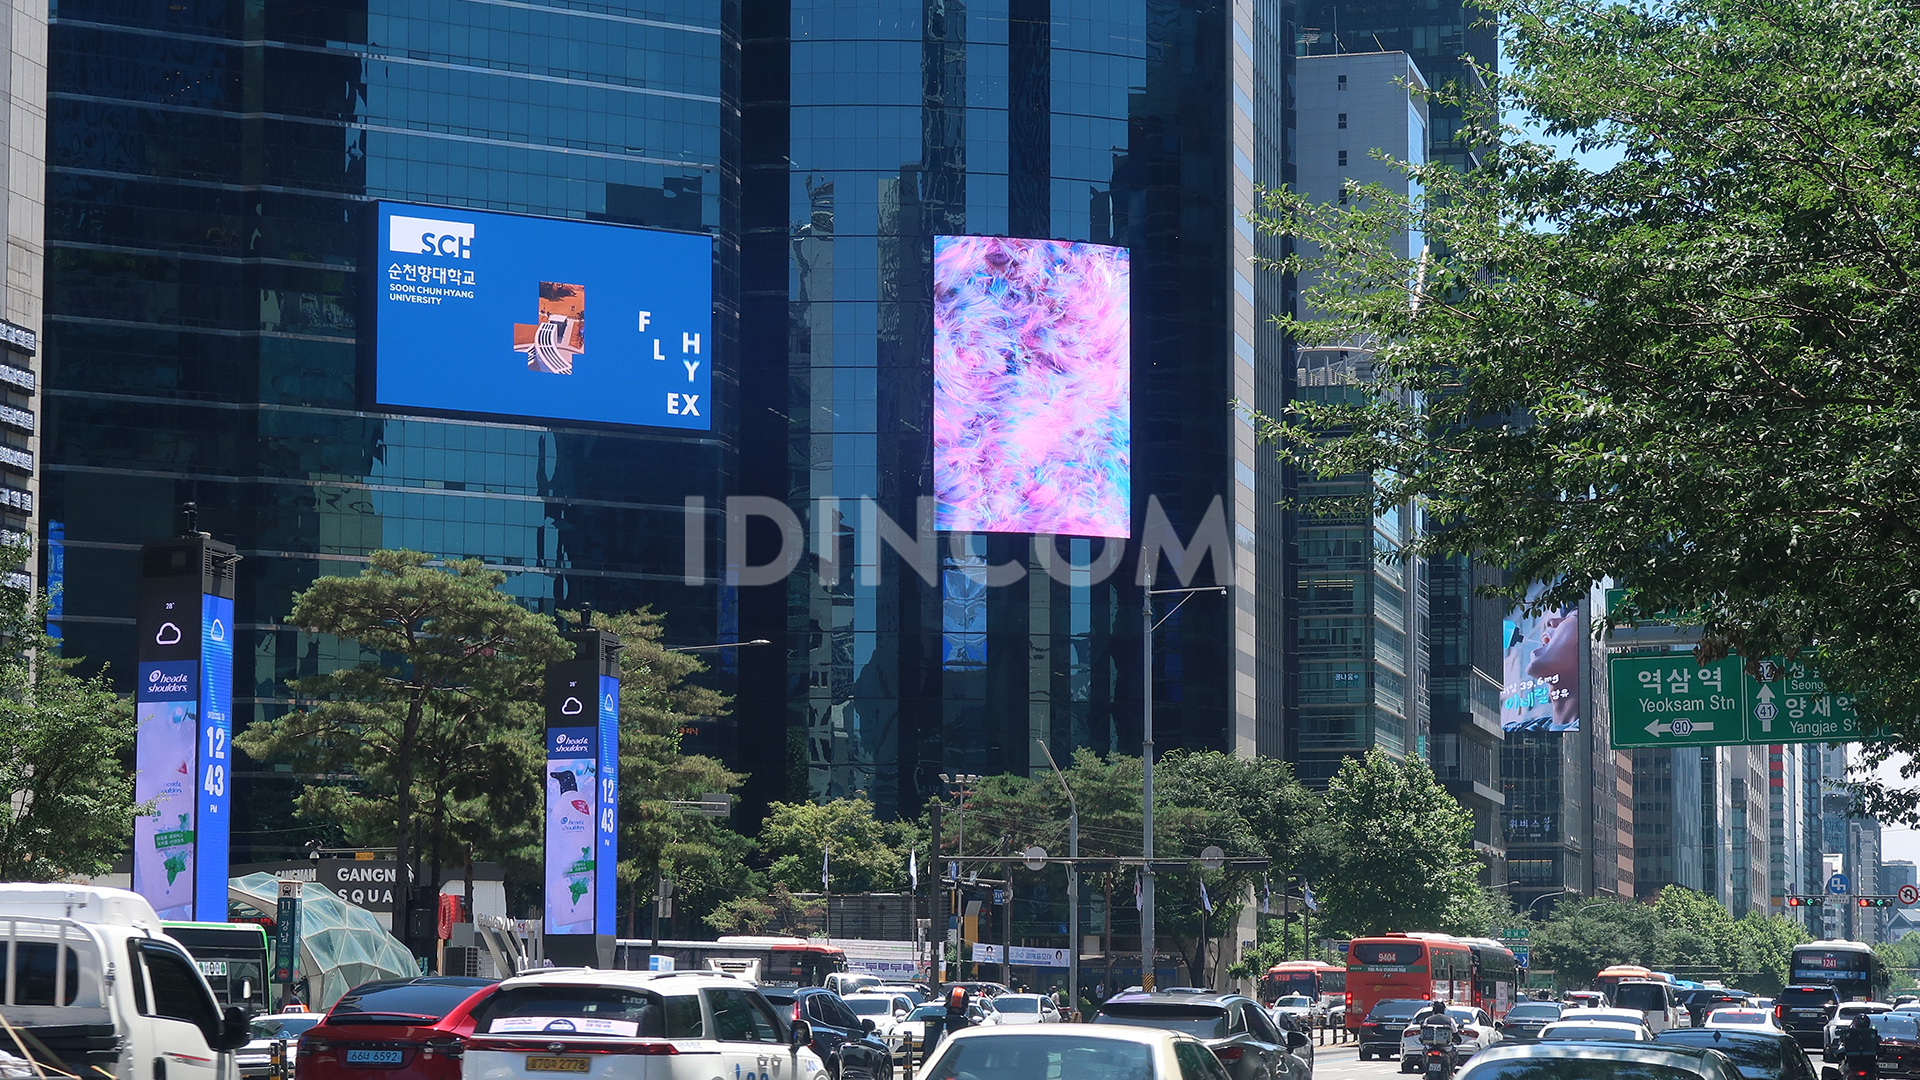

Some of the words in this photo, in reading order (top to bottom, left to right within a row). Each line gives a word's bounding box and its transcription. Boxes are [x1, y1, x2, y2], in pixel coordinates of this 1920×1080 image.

[421, 232, 470, 258] SCH
[388, 263, 476, 286] 순천향대학교
[389, 283, 416, 293] SOON
[416, 286, 442, 296] CHUN
[443, 289, 474, 299] HYANG
[389, 293, 442, 305] UNIVERSITY
[148, 683, 188, 693] shoulders
[1520, 674, 1559, 690] 39.6mg
[1638, 667, 1721, 694] 역삼역
[1791, 679, 1824, 691] Seong
[1639, 698, 1705, 712] Yeoksam
[1710, 695, 1735, 710] Stn
[1760, 706, 1772, 717] 41
[1674, 721, 1688, 733] 90
[1789, 720, 1838, 737] Yangjae
[206, 726, 225, 759] 12
[555, 744, 588, 753] shoulders
[204, 764, 224, 797] 43
[602, 778, 615, 804] 12
[209, 804, 218, 813] PM
[601, 808, 615, 833] 43
[337, 867, 397, 883] GANGN
[337, 889, 394, 904] SQUA
[281, 901, 291, 910] 11
[280, 920, 290, 943] 강남
[1378, 953, 1396, 962] 9404
[1823, 959, 1836, 968] 1241
[373, 1051, 398, 1061] 6592
[559, 1059, 586, 1070] 2778
